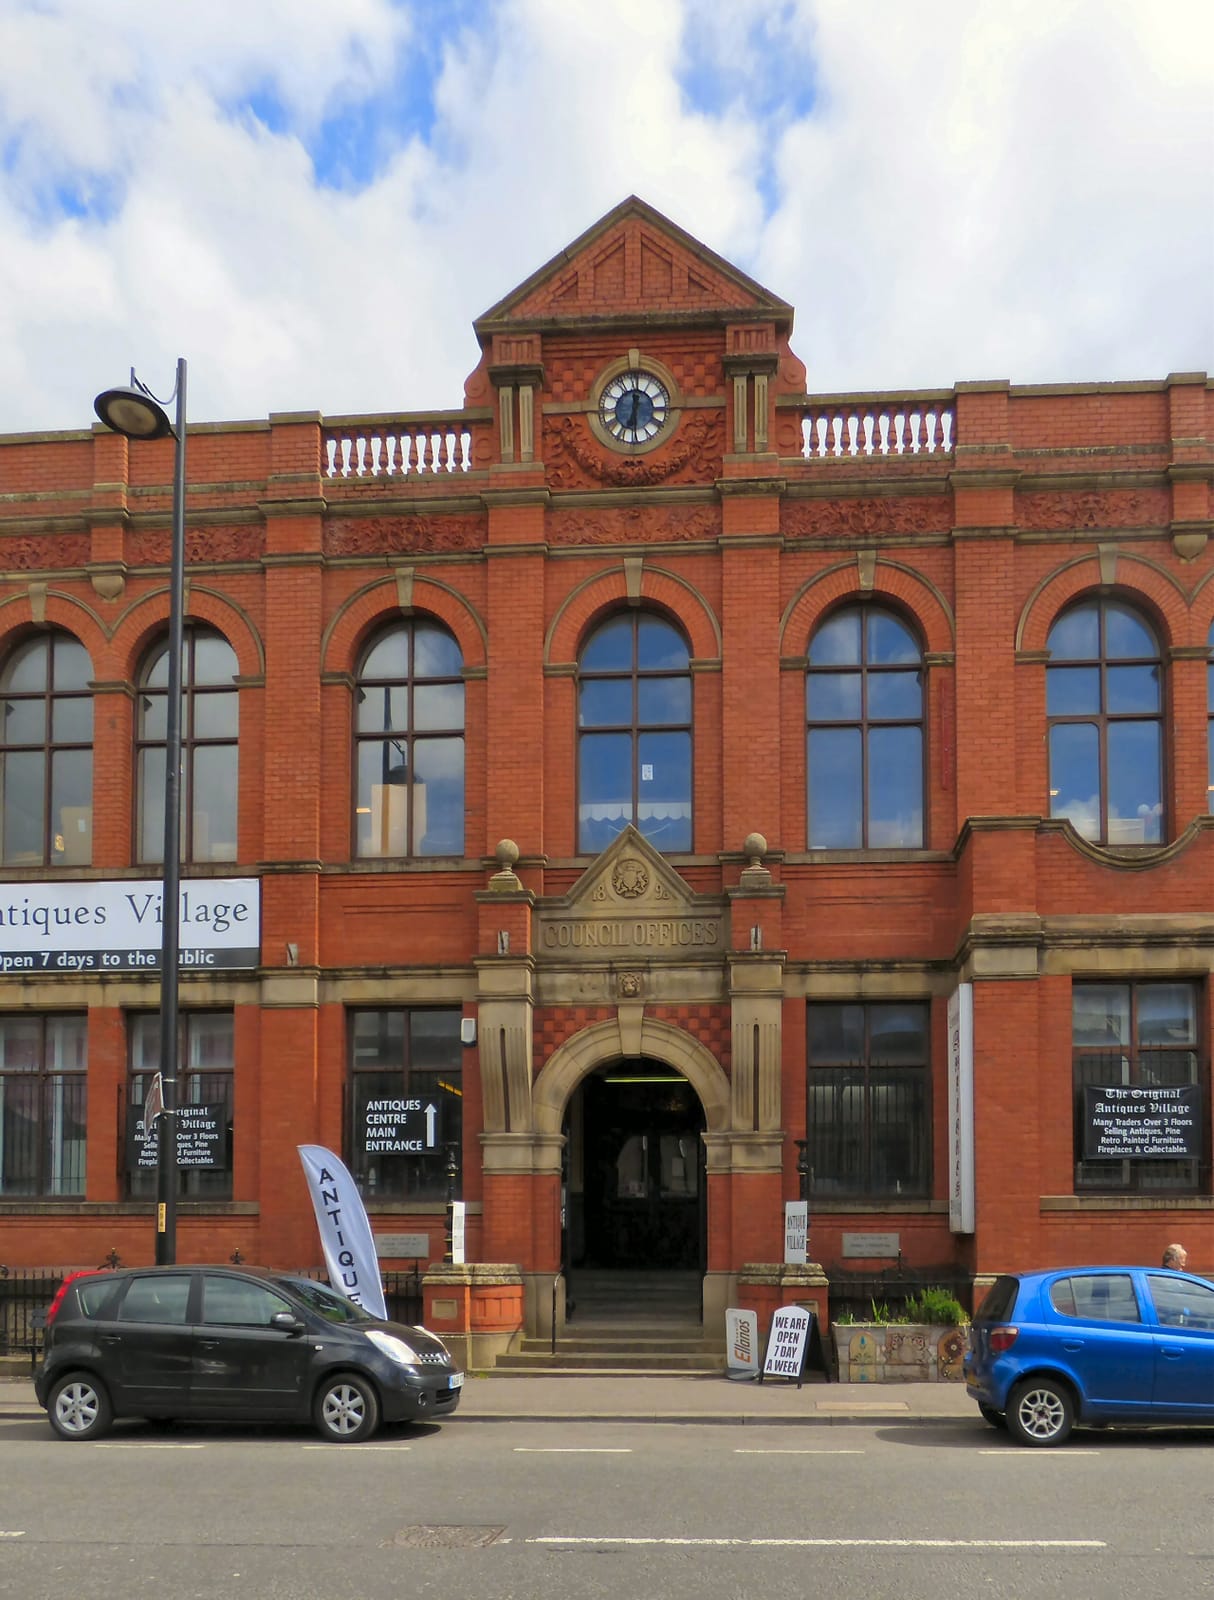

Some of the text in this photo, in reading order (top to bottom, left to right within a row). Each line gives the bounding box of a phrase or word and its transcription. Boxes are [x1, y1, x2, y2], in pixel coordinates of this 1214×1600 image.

[125, 891, 249, 932] Vilage
[544, 922, 718, 947] COUNCIL OFFICES
[0, 954, 33, 970] pen
[40, 953, 50, 966] 7
[57, 952, 94, 969] days
[102, 954, 120, 966] to
[128, 952, 156, 965] the
[1105, 1089, 1180, 1100] The Original
[366, 1100, 421, 1111] ANTIQUES
[1095, 1102, 1190, 1114] Antiques Village
[176, 1107, 208, 1117] riginal
[366, 1113, 407, 1124] CENTRE
[1092, 1118, 1193, 1127] Many Traders Over 3 Floors
[181, 1119, 217, 1130] Village
[199, 1132, 219, 1140] Floors
[366, 1127, 396, 1138] MAIN
[1104, 1127, 1127, 1136] Selling
[1165, 1127, 1181, 1135] Pine
[365, 1140, 423, 1151] ENTRANCE
[1100, 1136, 1184, 1144] Retro Painted Furniture
[1097, 1145, 1132, 1154] Fireplaces
[1143, 1145, 1187, 1153] Collectables
[176, 1157, 214, 1165] Collectables
[775, 1316, 807, 1330] WE ARE
[777, 1331, 800, 1344] OPEN
[774, 1345, 797, 1358] 7 DAY
[766, 1359, 799, 1373] A WEEK
